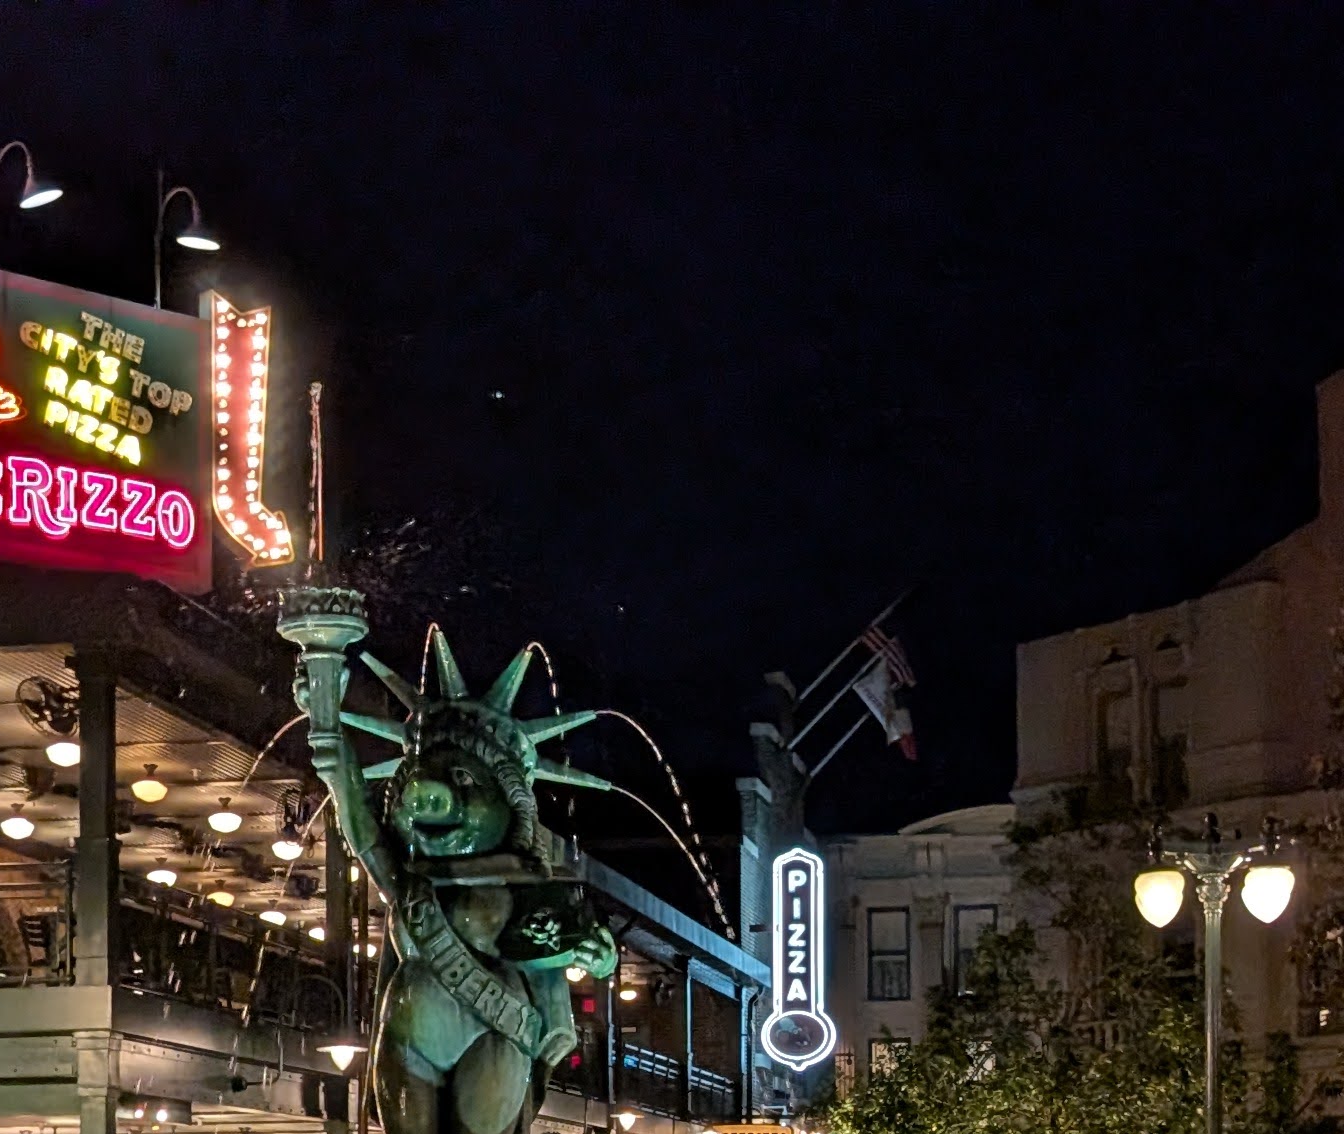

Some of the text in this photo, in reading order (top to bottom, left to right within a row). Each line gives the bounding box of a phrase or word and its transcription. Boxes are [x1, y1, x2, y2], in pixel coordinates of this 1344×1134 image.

[19, 320, 193, 416] CITY'S TOP
[81, 311, 145, 365] THE
[43, 365, 153, 434] RATED
[43, 399, 142, 467] PIZZA
[787, 869, 808, 1001] PIZZA
[426, 928, 539, 1048] LIBERTY
